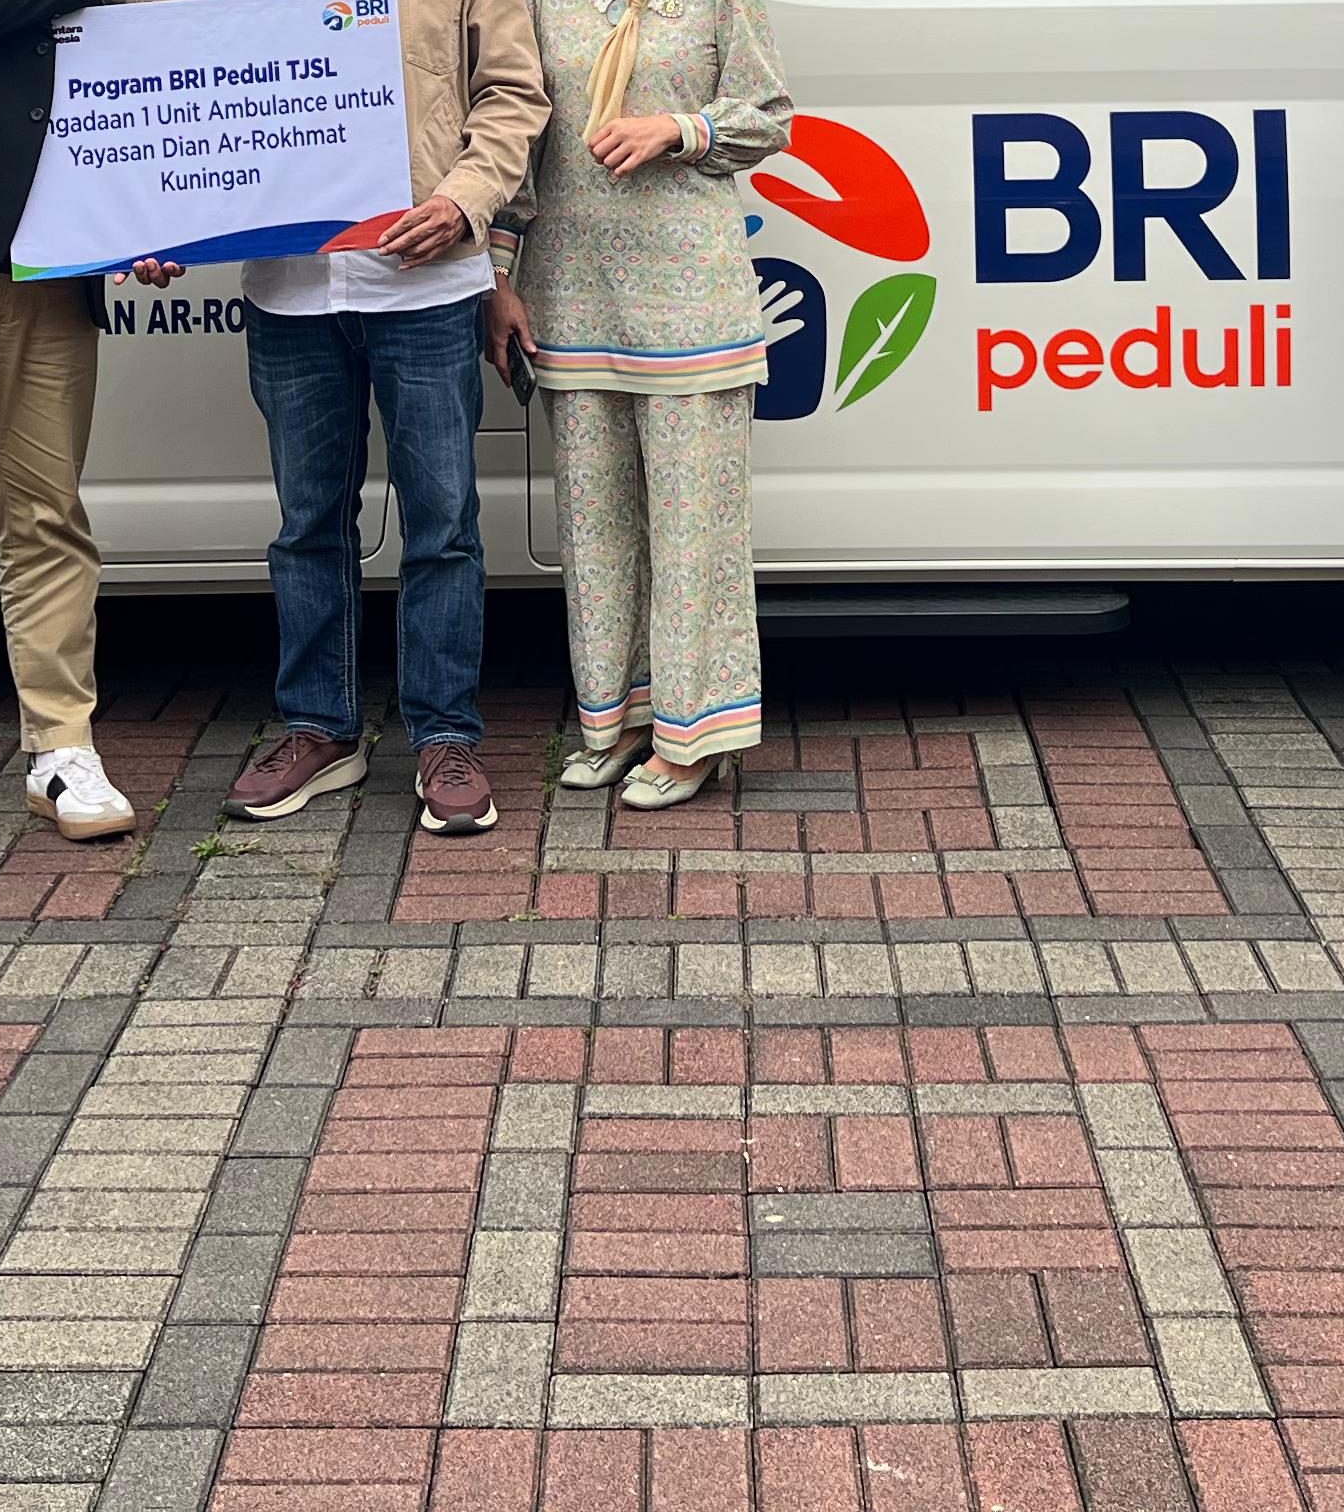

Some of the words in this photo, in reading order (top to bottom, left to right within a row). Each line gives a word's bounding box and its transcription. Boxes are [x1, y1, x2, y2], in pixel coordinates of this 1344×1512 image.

[358, 16, 390, 29] peduli
[68, 76, 162, 100] Program
[169, 68, 206, 90] BRI
[213, 61, 280, 87] Peduli
[286, 57, 338, 80] TJSL
[141, 106, 149, 127] 1
[157, 101, 201, 125] Unit
[208, 94, 328, 121] Ambulance
[335, 85, 395, 110] untuk
[68, 143, 155, 169] Yayasan
[162, 135, 210, 158] Dian
[218, 123, 347, 154] Ar-Rokhmat
[161, 167, 261, 192] Kuningan
[971, 109, 1291, 284] BRI
[146, 297, 247, 335] AR-RO
[977, 303, 1292, 412] peduli
